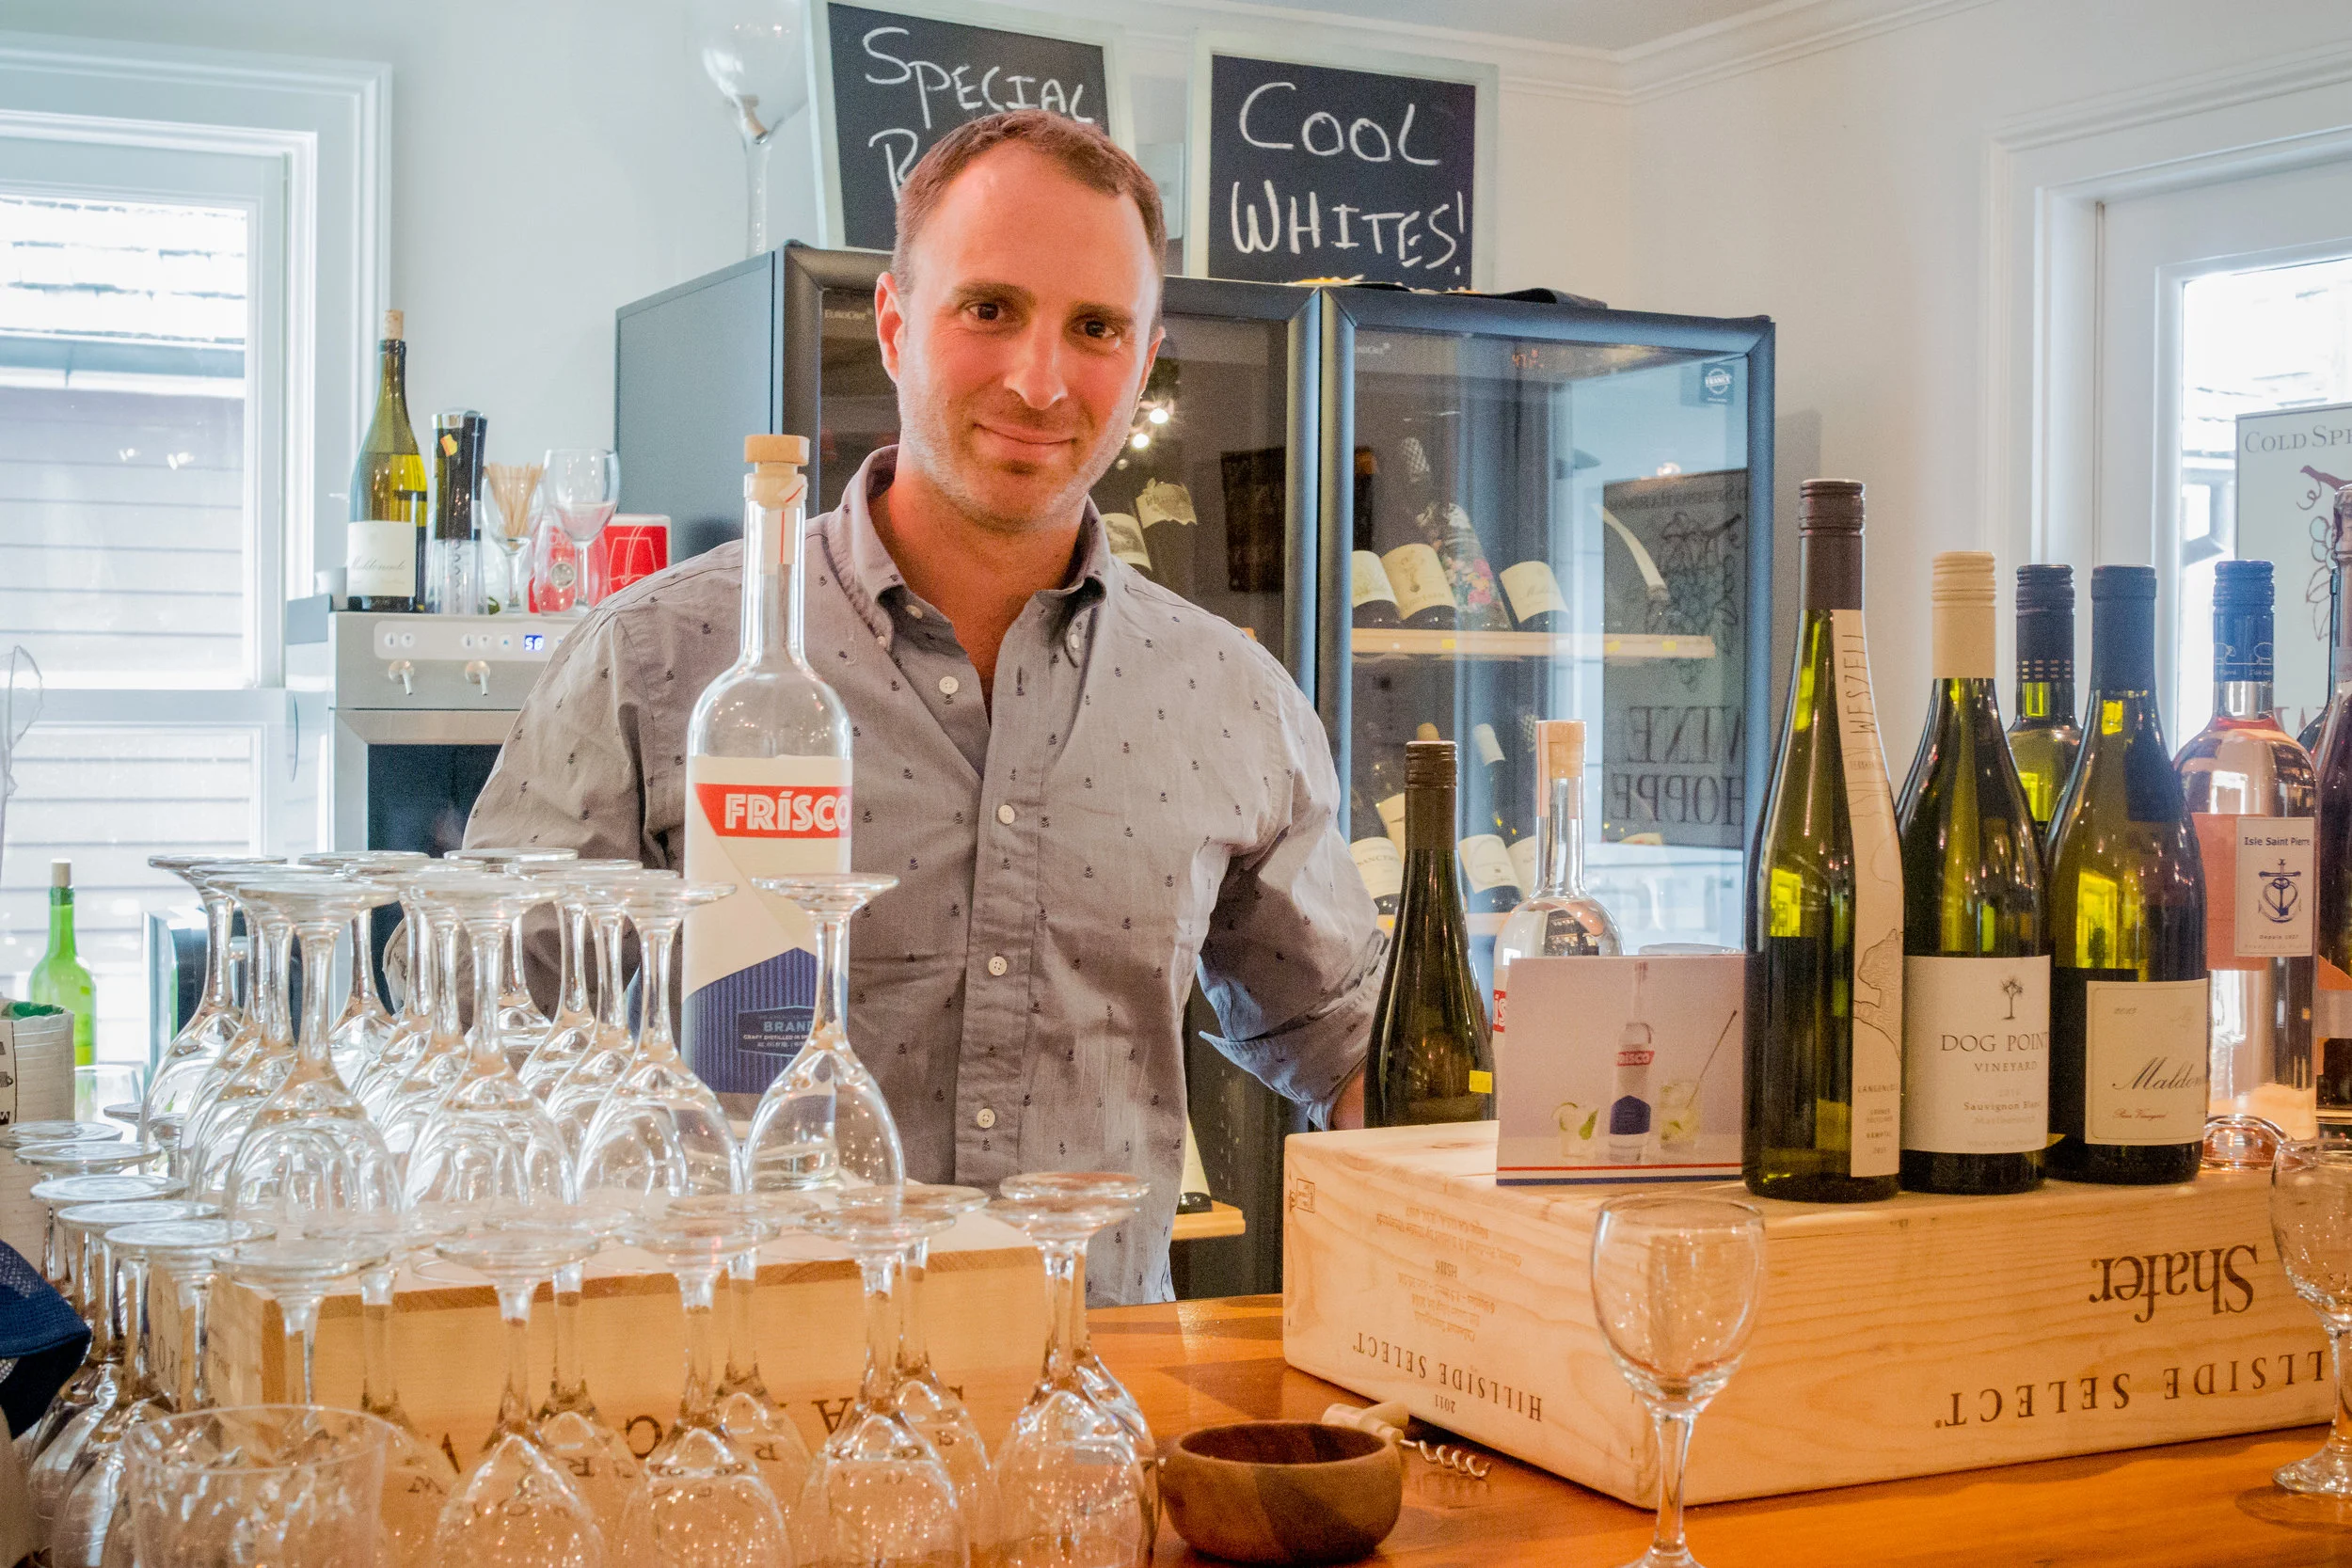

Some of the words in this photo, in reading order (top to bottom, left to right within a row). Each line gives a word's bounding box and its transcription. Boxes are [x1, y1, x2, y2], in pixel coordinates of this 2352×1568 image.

[863, 26, 1095, 130] SPECIAL
[1239, 82, 1440, 166] COOL
[1231, 179, 1466, 276] WHITES!
[2245, 431, 2307, 452] COLD
[2244, 836, 2263, 846] Isle
[2265, 836, 2289, 846] Saint
[1941, 1034, 1996, 1052] DOG
[1974, 1060, 2038, 1072] VINEYARD
[1963, 1101, 2020, 1113] Sauvignon
[2088, 1243, 2259, 1323] Shafer
[1438, 1362, 1542, 1422] HILLSIDE
